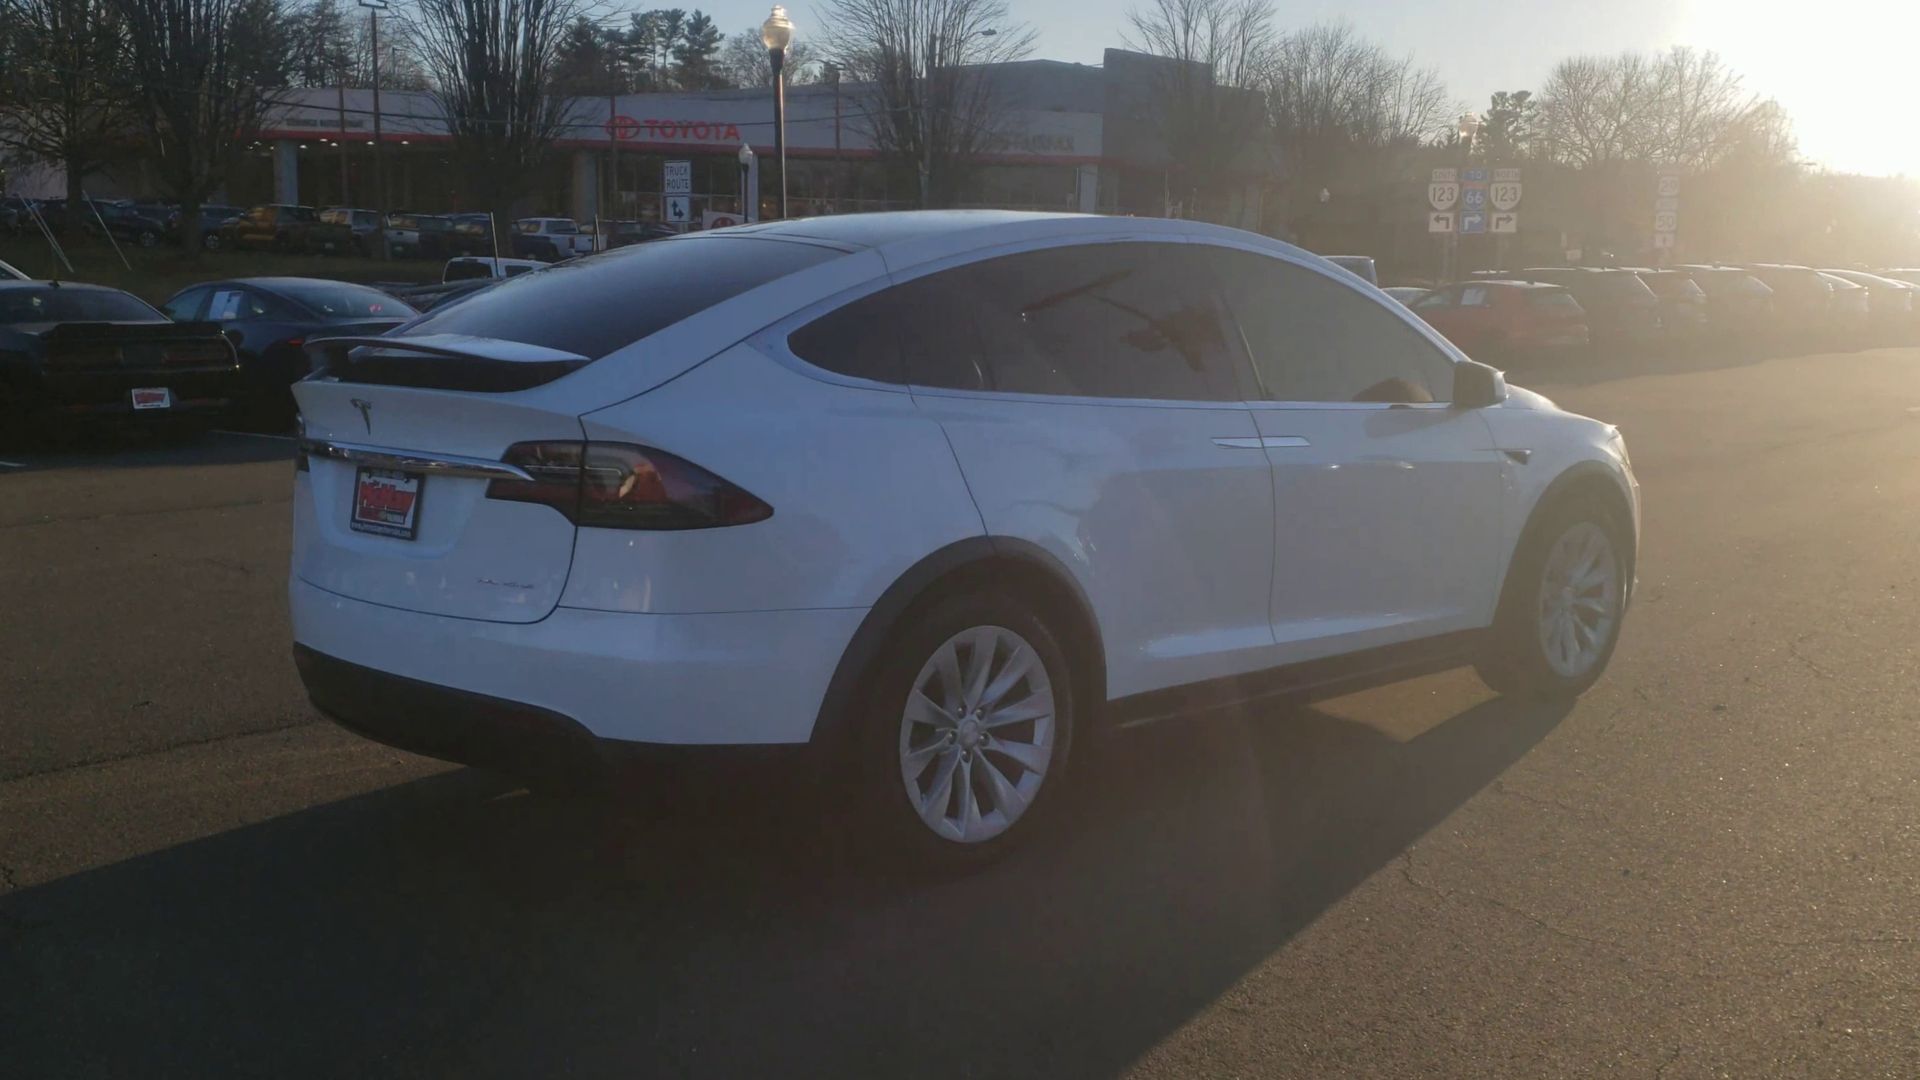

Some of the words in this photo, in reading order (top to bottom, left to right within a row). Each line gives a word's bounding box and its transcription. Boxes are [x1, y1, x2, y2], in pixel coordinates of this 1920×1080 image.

[643, 120, 741, 141] TOYOTA
[666, 166, 688, 176] TRUCK
[666, 178, 689, 189] ROUTE
[1432, 187, 1455, 202] 123
[1466, 191, 1483, 204] 66
[1494, 187, 1518, 202] 123
